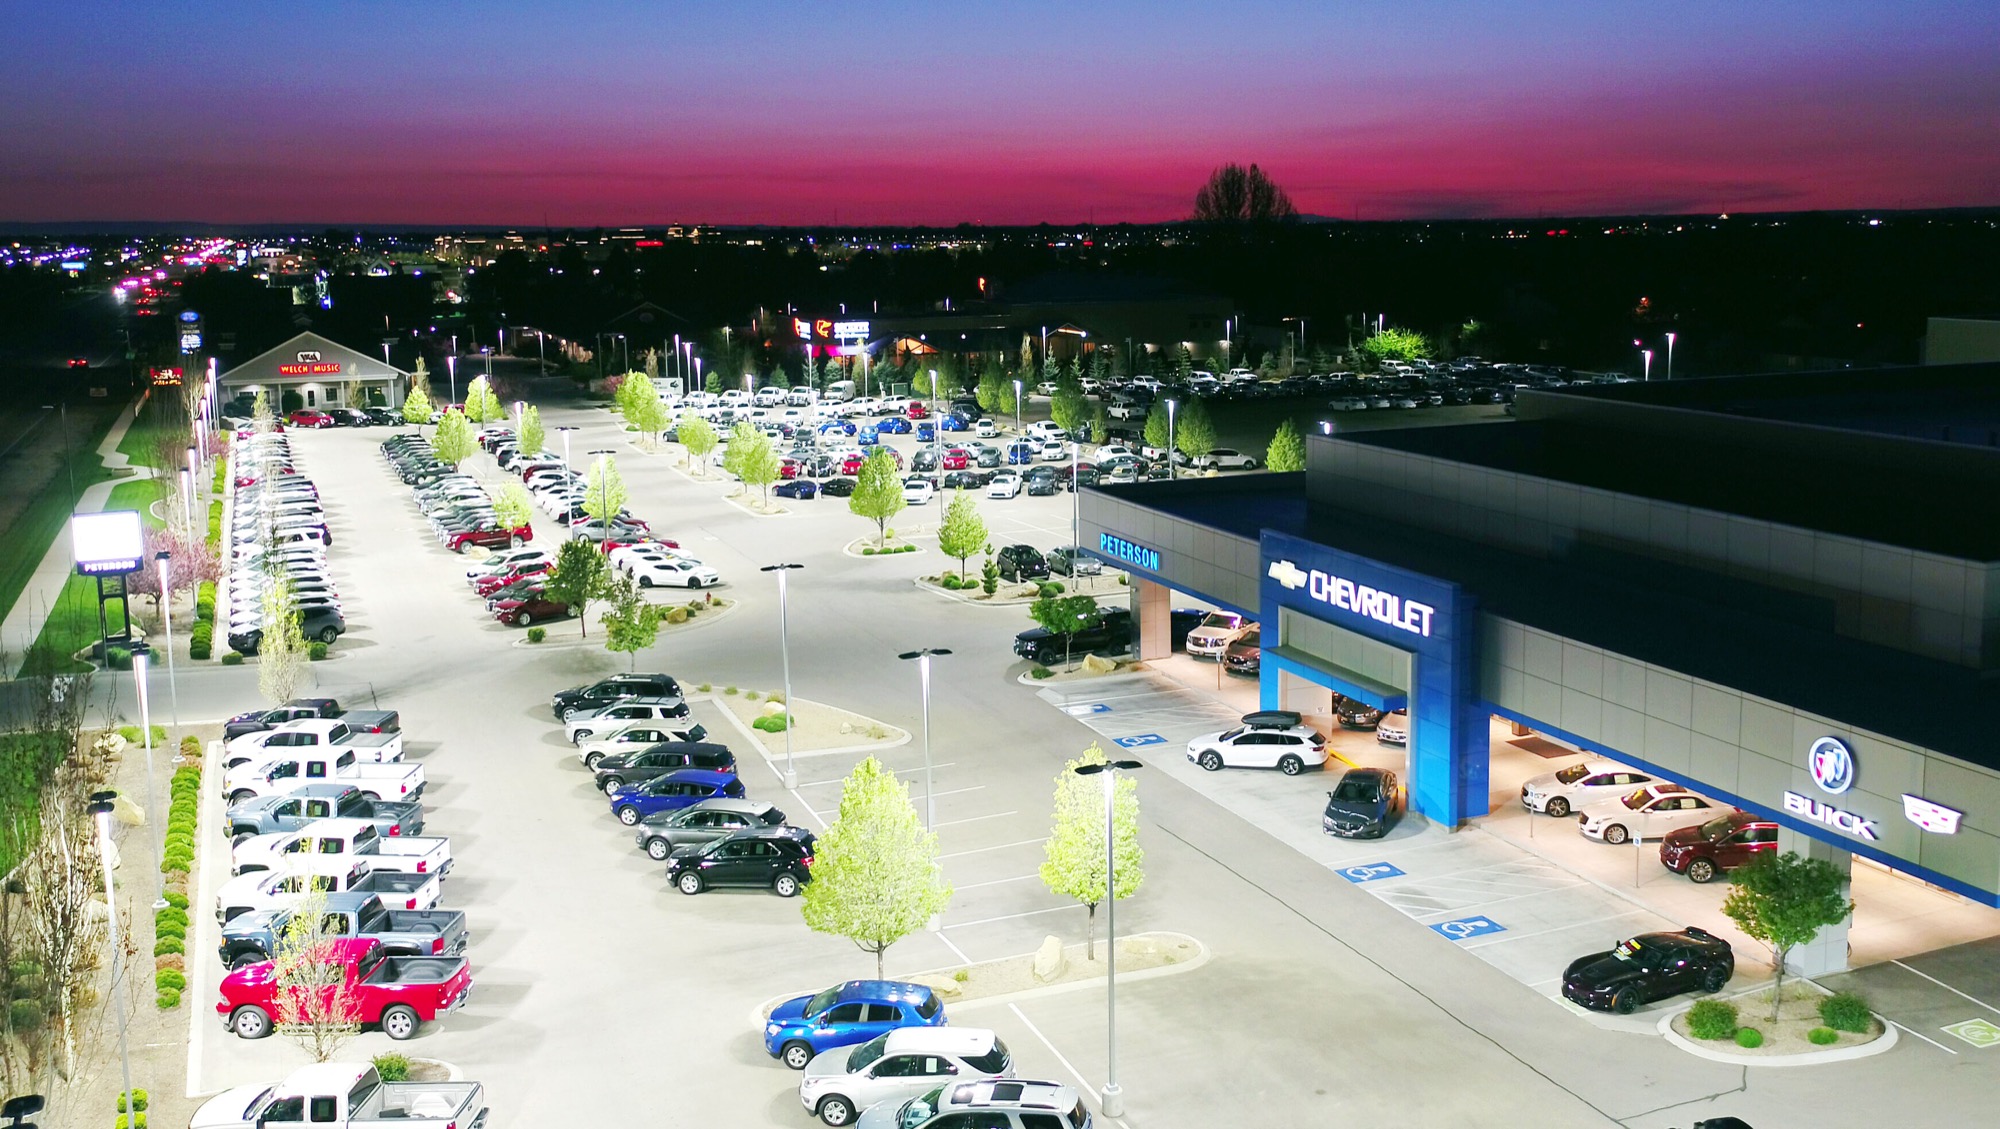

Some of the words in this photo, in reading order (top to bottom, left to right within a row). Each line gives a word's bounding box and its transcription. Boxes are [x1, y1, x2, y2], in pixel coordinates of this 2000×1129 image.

[280, 365, 309, 374] WELCH
[313, 364, 340, 373] MUSIC
[84, 560, 136, 573] PETERSON
[1100, 533, 1159, 571] PETERSON
[1309, 569, 1435, 637] CHEVROLET
[1783, 790, 1878, 841] BUICK
